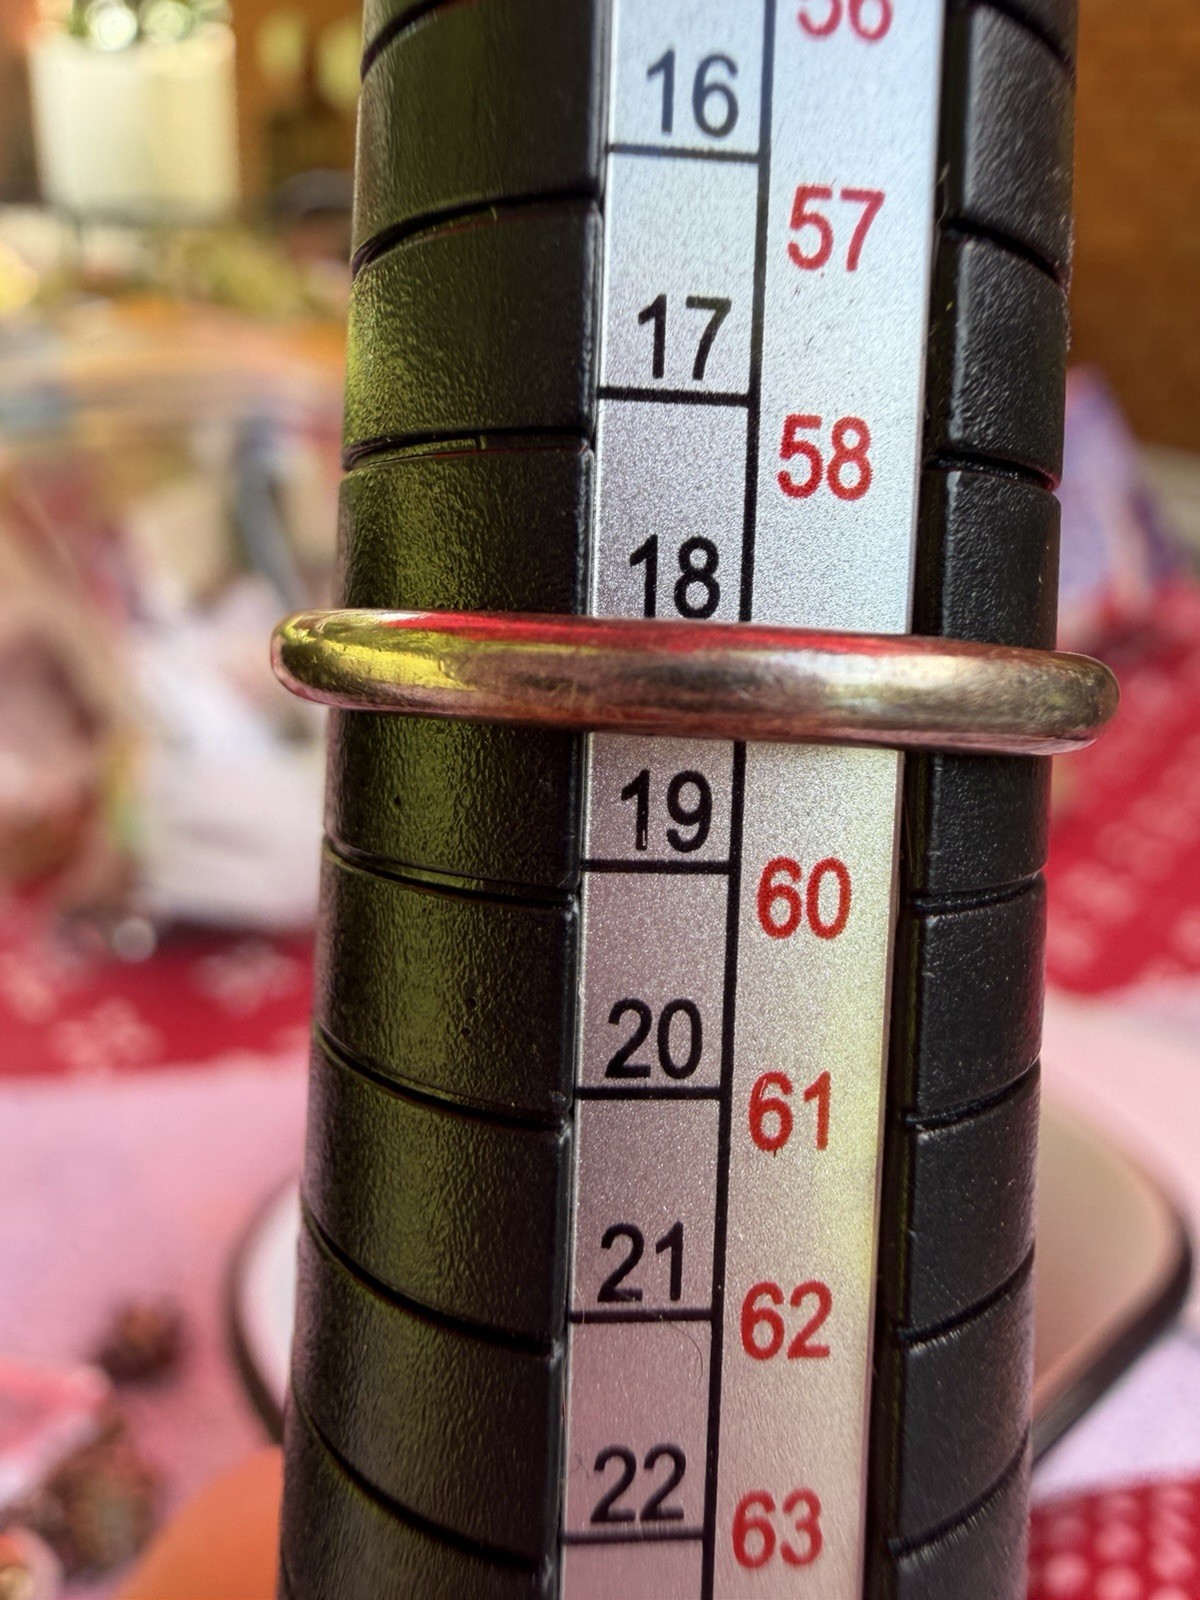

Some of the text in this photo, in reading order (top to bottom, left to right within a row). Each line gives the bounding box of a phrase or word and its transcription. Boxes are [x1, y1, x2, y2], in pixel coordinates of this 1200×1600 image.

[647, 49, 739, 137] 16
[787, 183, 884, 271] 57
[638, 293, 732, 381] 17
[777, 413, 873, 500] 58
[629, 534, 721, 619] 18
[620, 768, 713, 853] 19
[756, 856, 851, 939] 60
[604, 997, 704, 1081] 20
[747, 1070, 831, 1153] 61
[597, 1221, 684, 1303] 21
[739, 1280, 833, 1361] 62
[589, 1443, 687, 1525] 22
[730, 1487, 824, 1569] 63
